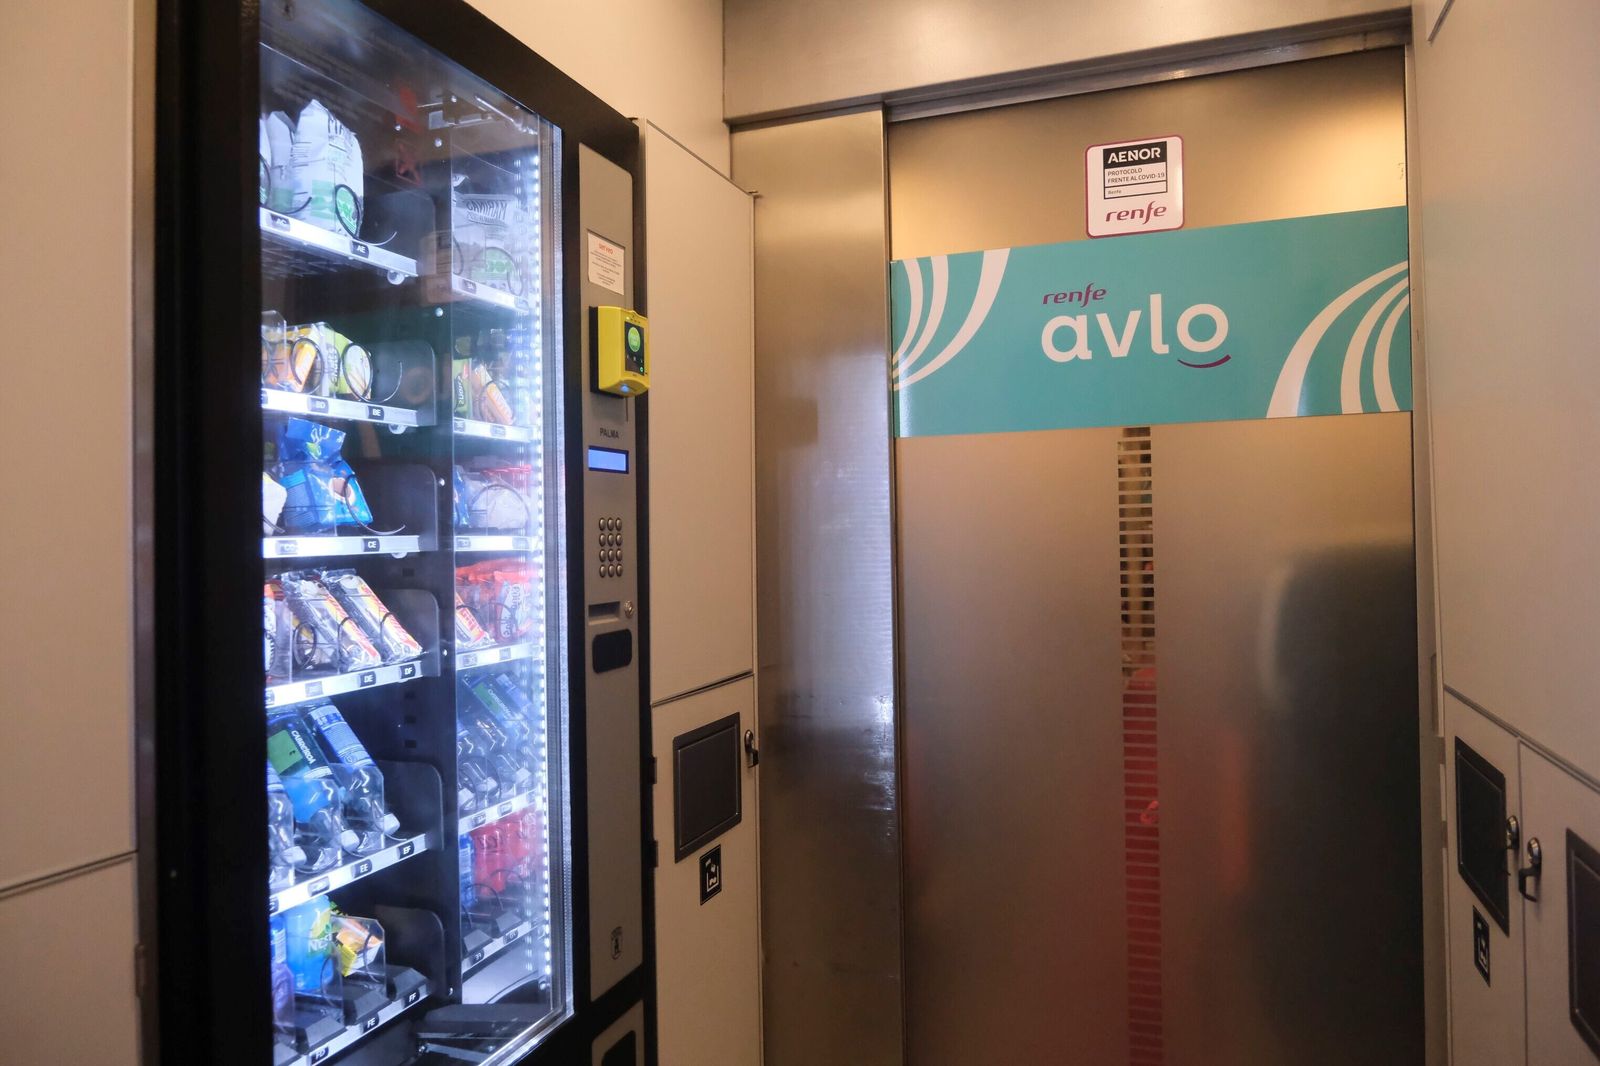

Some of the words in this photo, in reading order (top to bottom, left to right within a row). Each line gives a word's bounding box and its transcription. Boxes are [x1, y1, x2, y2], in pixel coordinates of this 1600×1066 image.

[1108, 147, 1161, 164] AENOR
[1107, 168, 1143, 177] PROTOCOLO
[1107, 175, 1130, 184] FRENTE
[1138, 172, 1165, 180] COVID-19
[1105, 200, 1167, 225] renfe
[1042, 282, 1107, 308] renfe
[1041, 293, 1229, 363] avlo
[372, 409, 382, 418] BE
[599, 427, 620, 440] PALMA
[367, 541, 377, 549] CE
[363, 674, 374, 684] DE
[402, 845, 412, 856] EF
[359, 863, 369, 873] EE
[407, 991, 417, 1002] FF
[366, 1017, 376, 1028] FE
